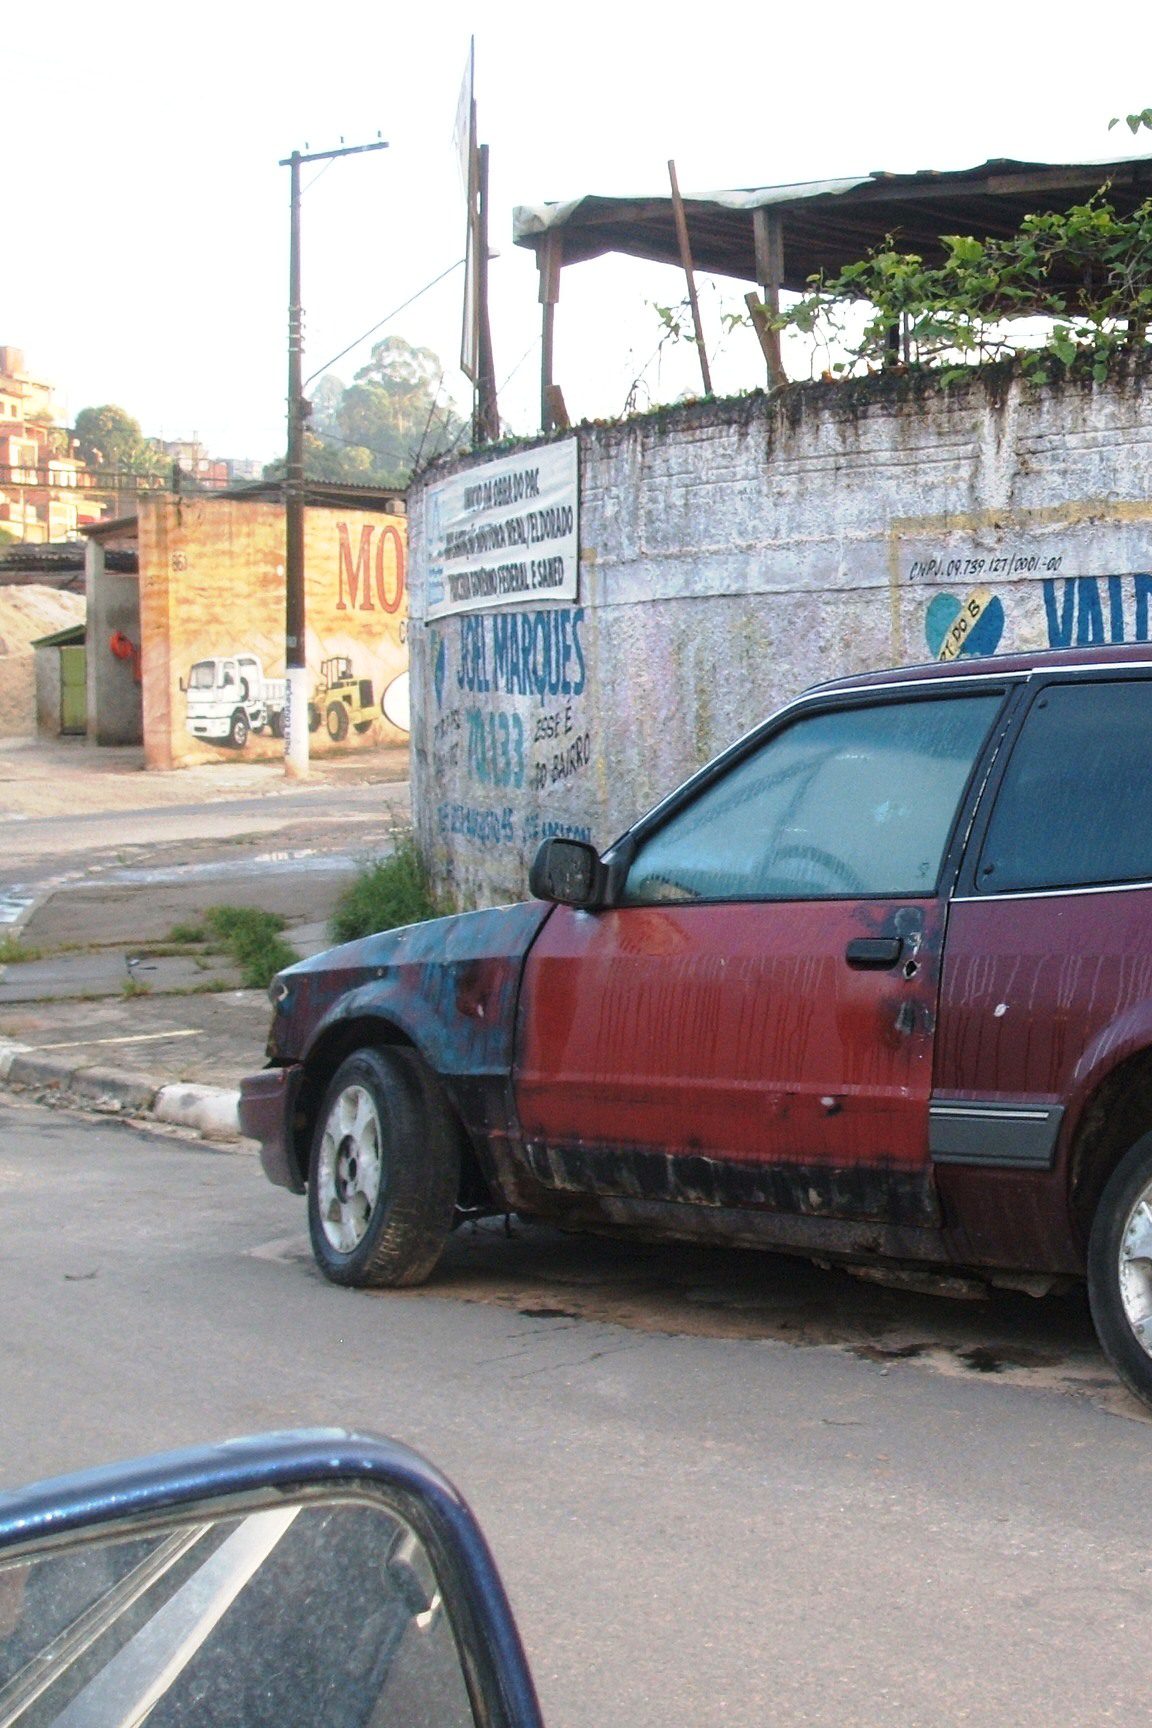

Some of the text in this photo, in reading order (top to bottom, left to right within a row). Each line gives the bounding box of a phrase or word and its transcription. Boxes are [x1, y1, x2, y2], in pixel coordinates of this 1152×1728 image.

[524, 467, 540, 499] PAC
[952, 618, 969, 643] DO
[457, 607, 586, 700] JOEL MARQUES
[550, 732, 591, 784] BAIRRO
